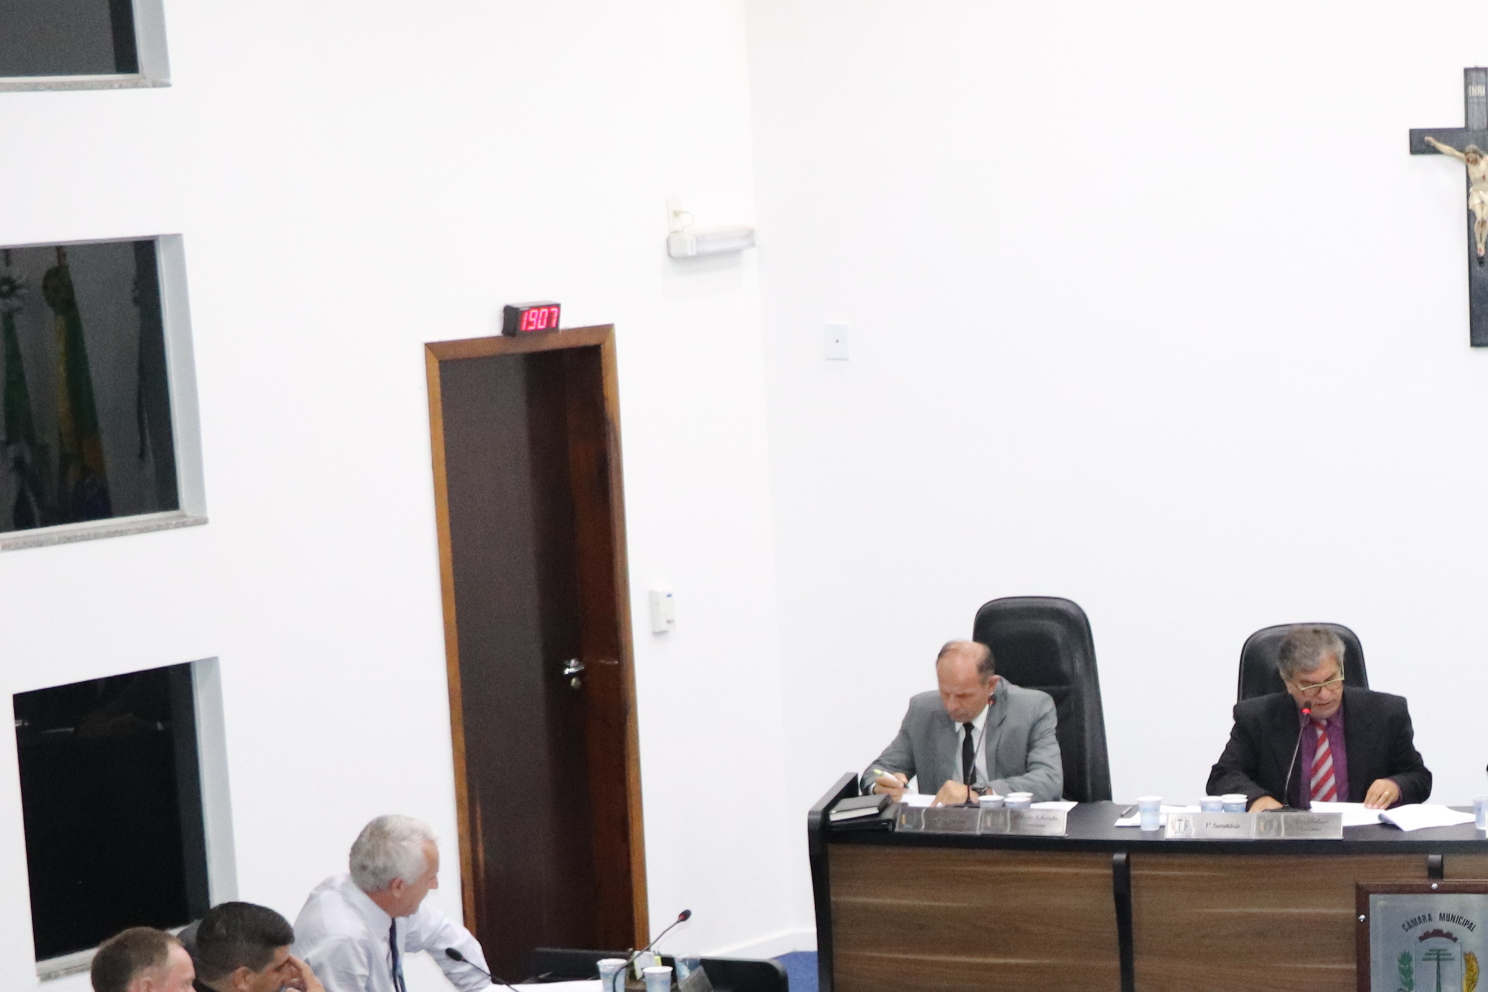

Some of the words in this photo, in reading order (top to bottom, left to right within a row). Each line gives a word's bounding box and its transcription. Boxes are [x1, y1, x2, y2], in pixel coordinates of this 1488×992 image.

[1469, 85, 1485, 97] INRI
[522, 307, 559, 331] 1907
[1439, 912, 1477, 932] MUNICIPAL
